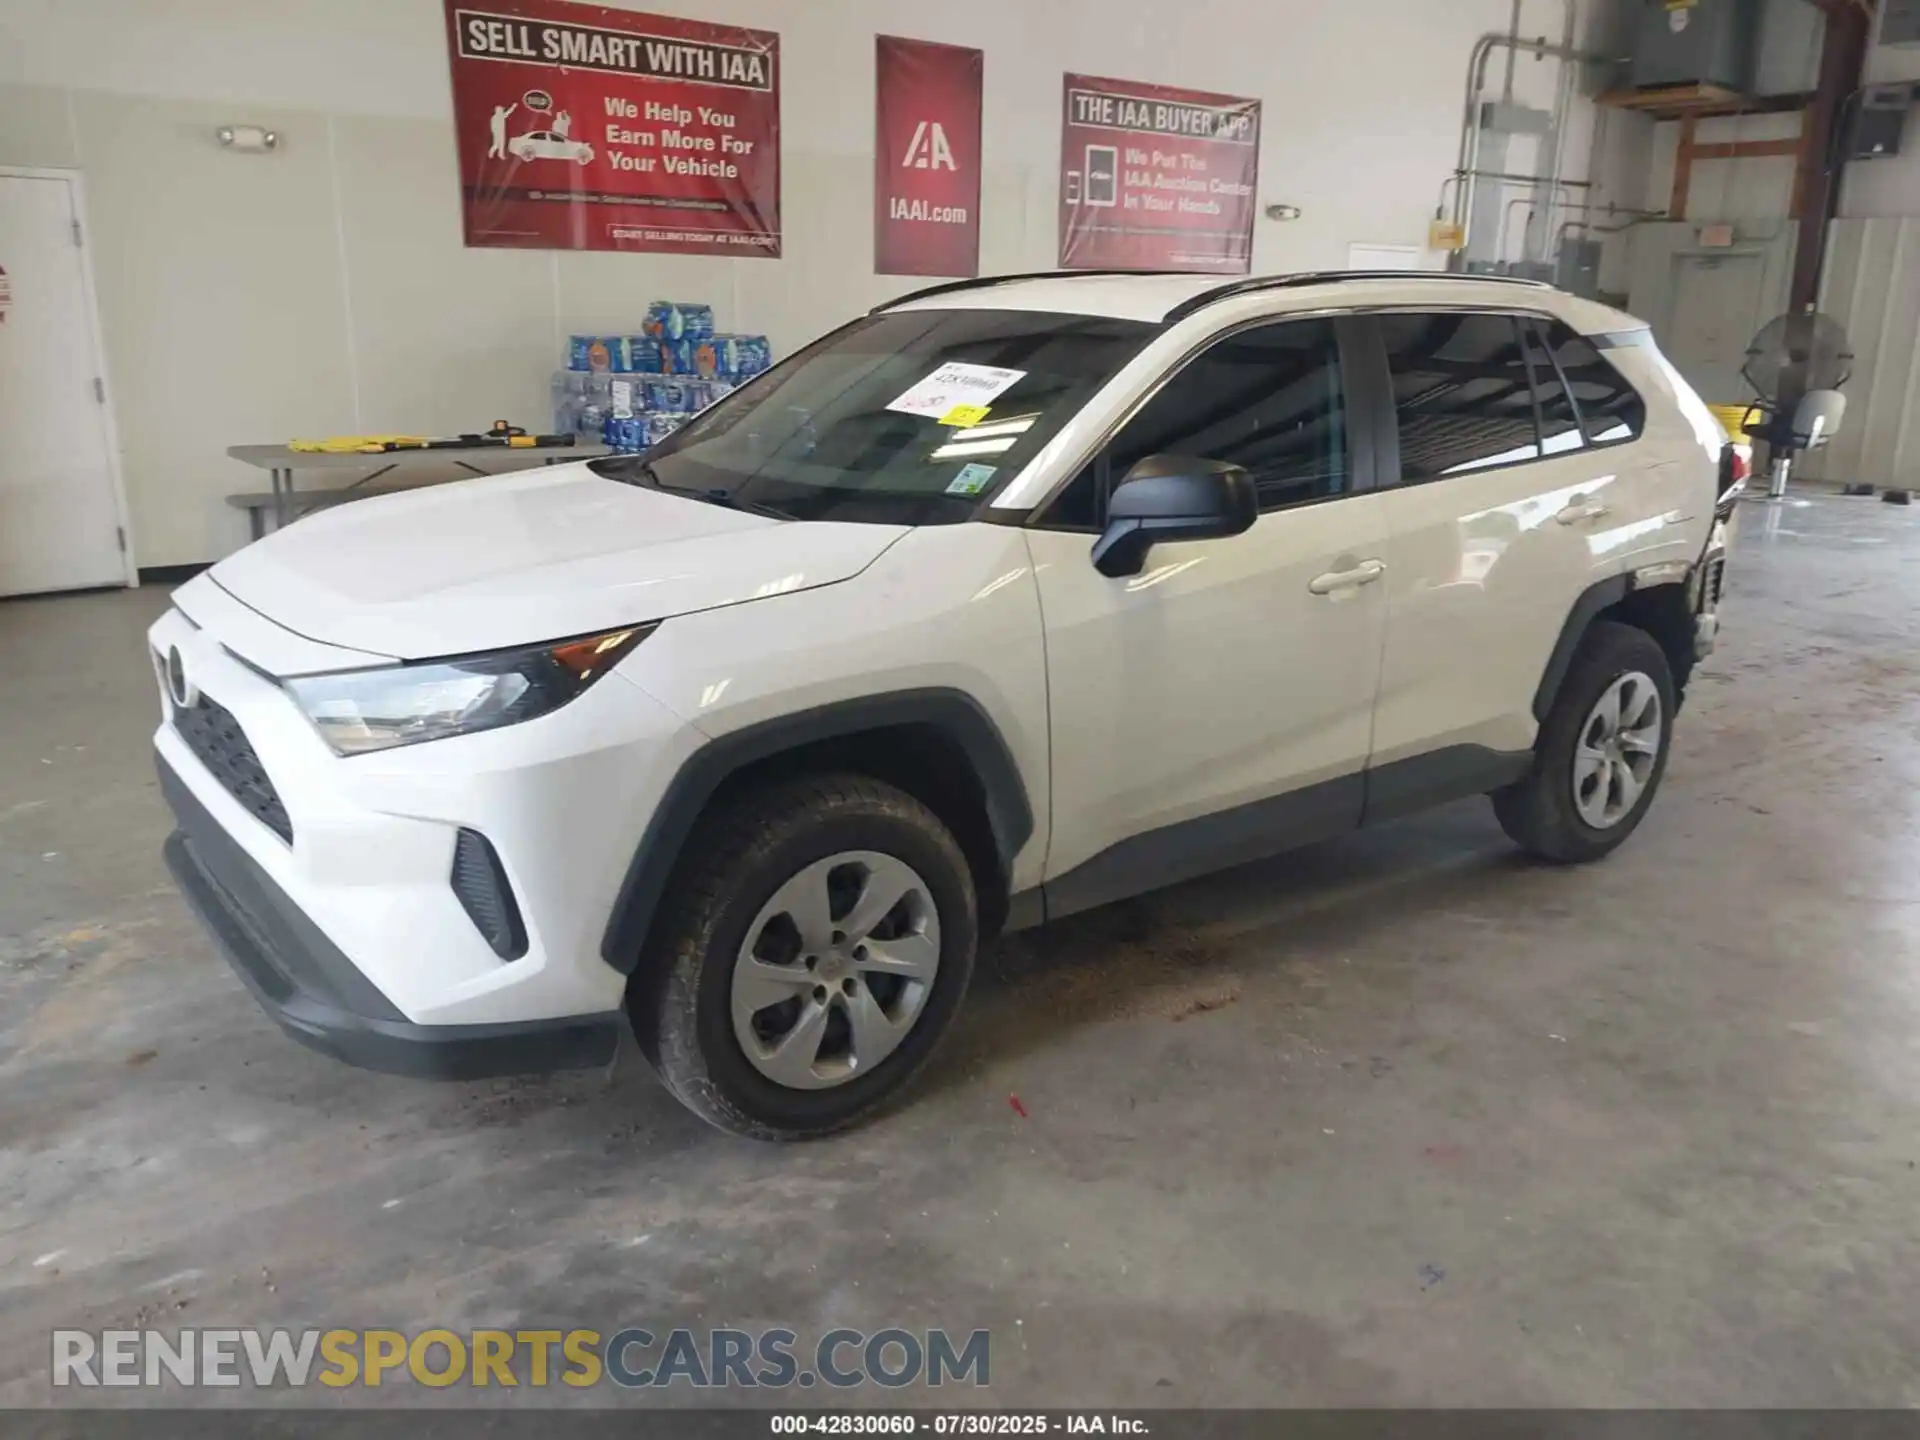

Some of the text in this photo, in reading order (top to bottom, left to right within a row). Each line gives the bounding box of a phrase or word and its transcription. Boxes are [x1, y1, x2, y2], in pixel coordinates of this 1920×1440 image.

[468, 19, 765, 85] SELL SMART WITH IAA
[604, 97, 736, 128] We Help You
[1076, 95, 1112, 124] THE
[1117, 100, 1150, 129] IAA
[1155, 105, 1212, 137] BUYER
[606, 124, 754, 155] Earn More For
[608, 150, 738, 179] Your Vehicle
